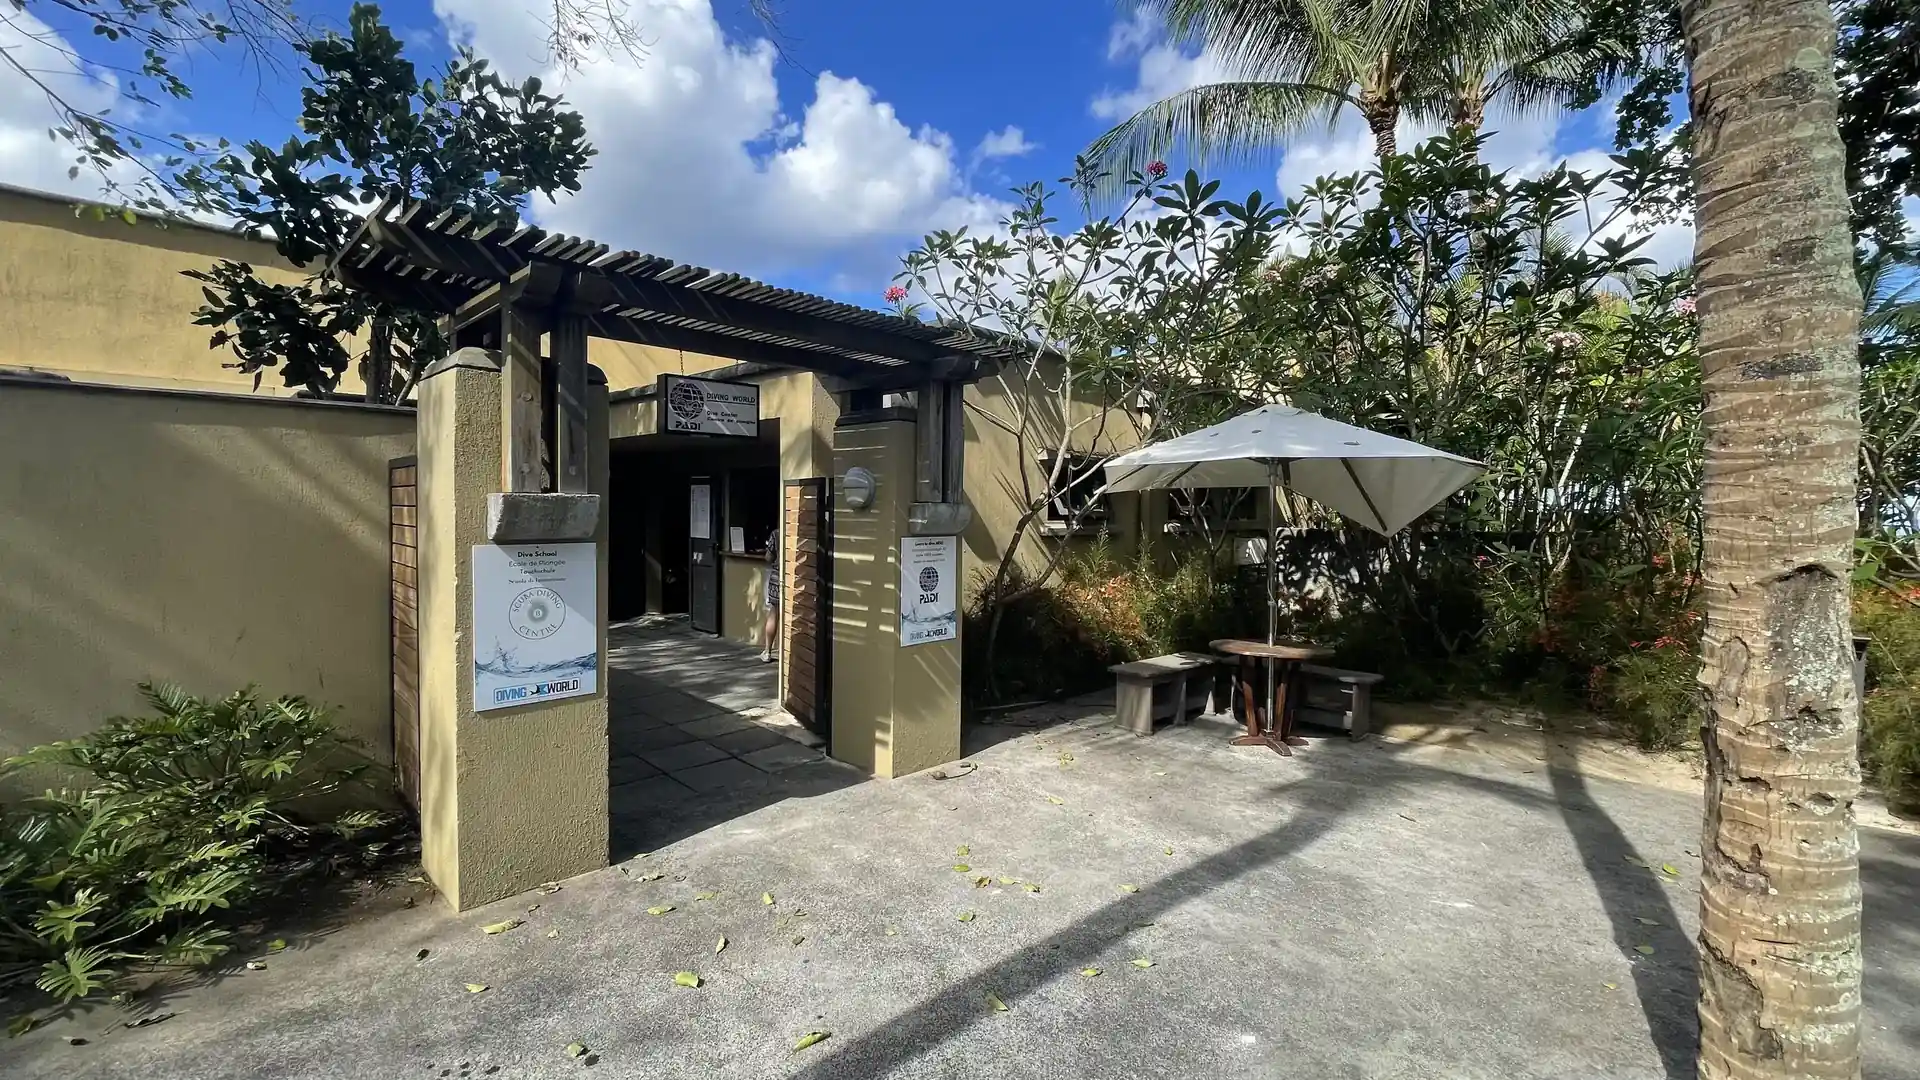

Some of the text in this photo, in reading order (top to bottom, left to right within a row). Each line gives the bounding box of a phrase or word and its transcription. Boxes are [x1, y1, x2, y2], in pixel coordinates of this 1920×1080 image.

[706, 392, 756, 403] DIVING WORLD
[675, 420, 701, 431] PADI
[534, 550, 558, 558] School
[536, 589, 562, 609] DIVING
[919, 592, 939, 605] PADI
[519, 623, 557, 637] CENTRE
[932, 627, 948, 637] WORLD
[496, 680, 579, 701] DIVING WORLD
